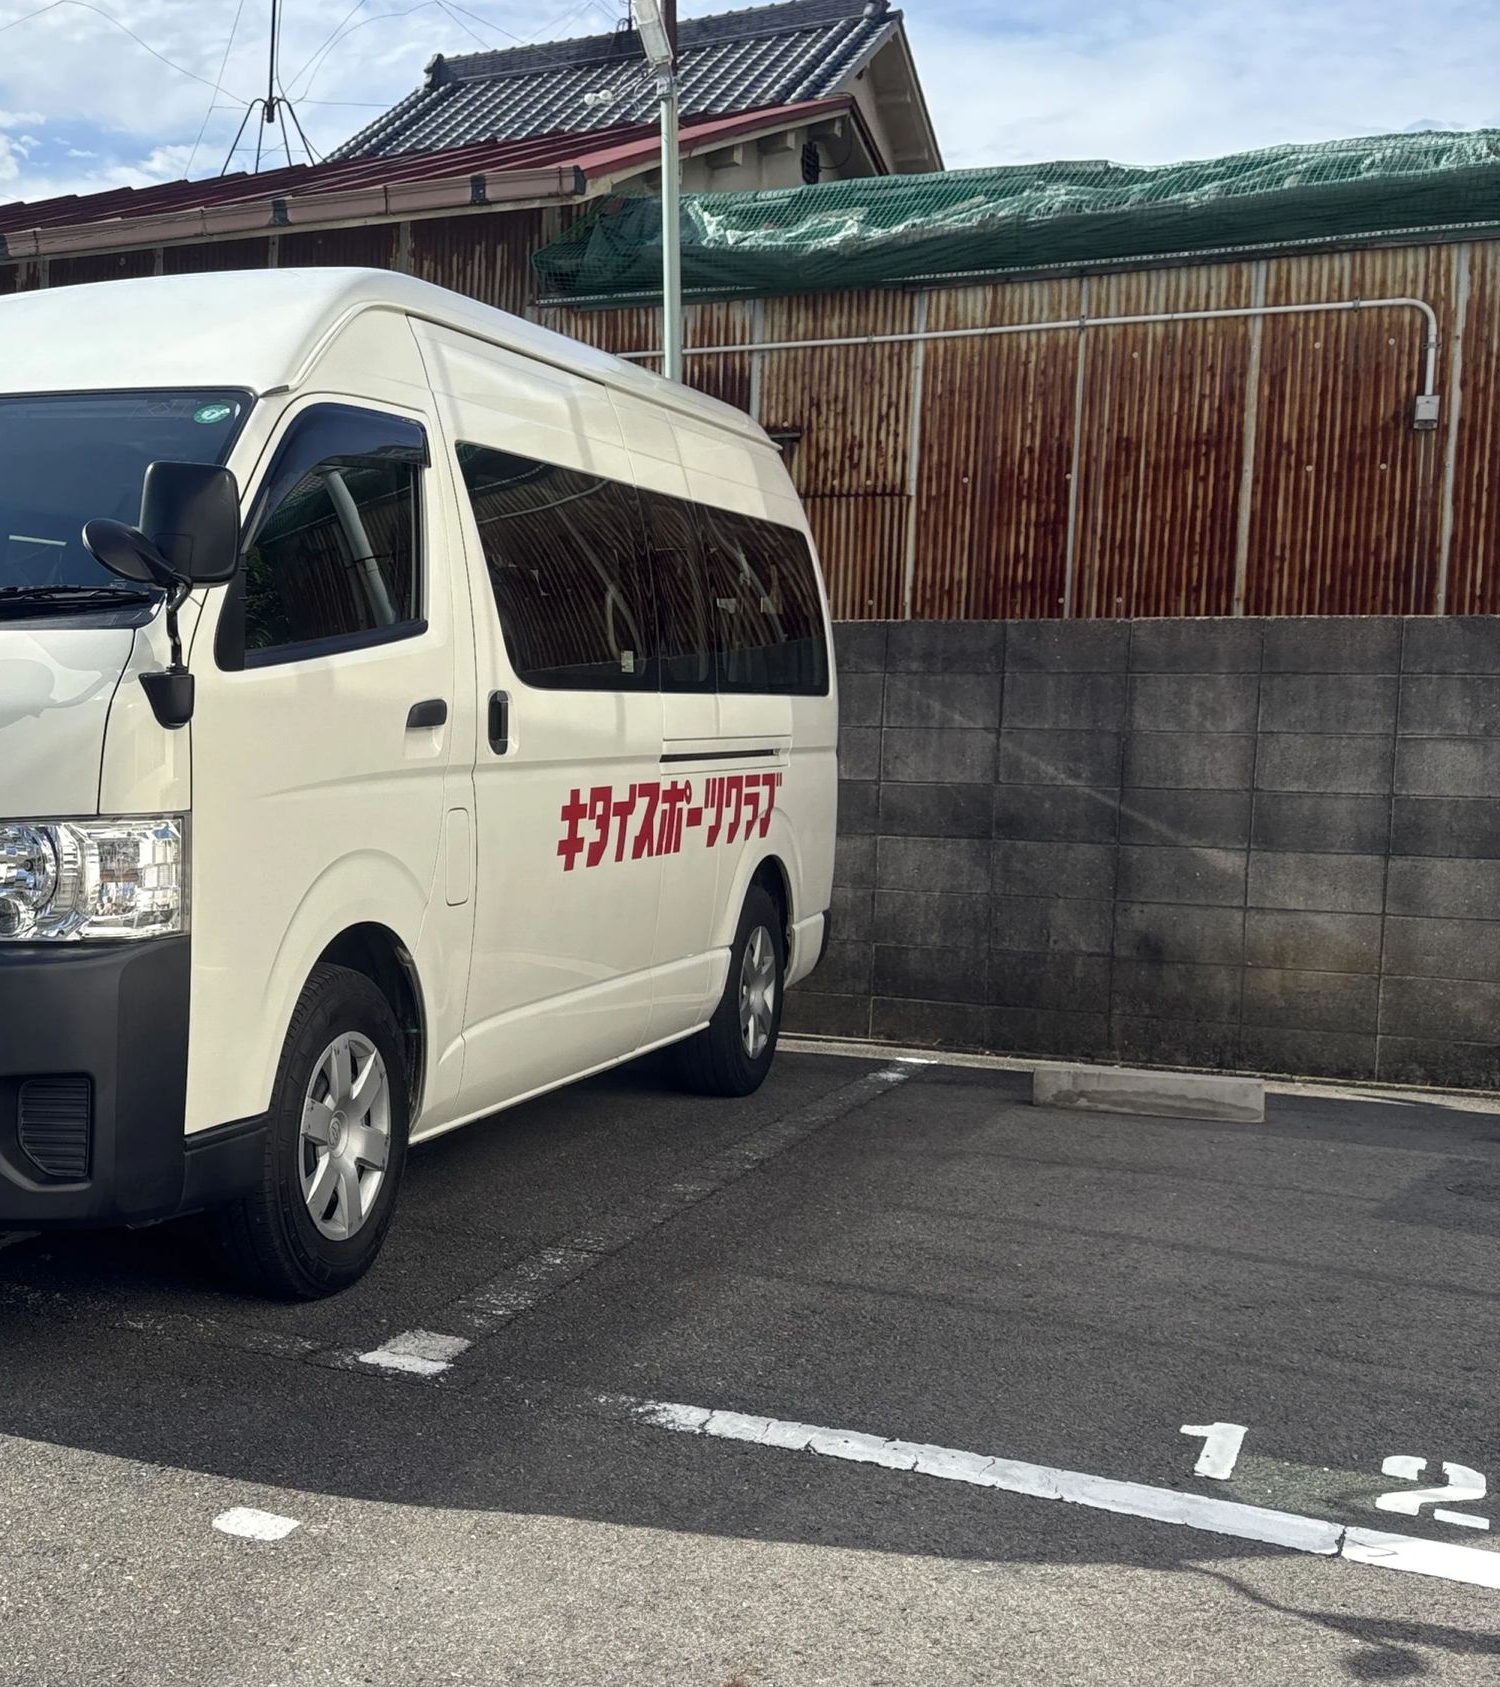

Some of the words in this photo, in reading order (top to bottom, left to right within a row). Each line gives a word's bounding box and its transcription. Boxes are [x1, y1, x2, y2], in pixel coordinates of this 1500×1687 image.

[557, 772, 783, 871] キタイスポーツクラブ
